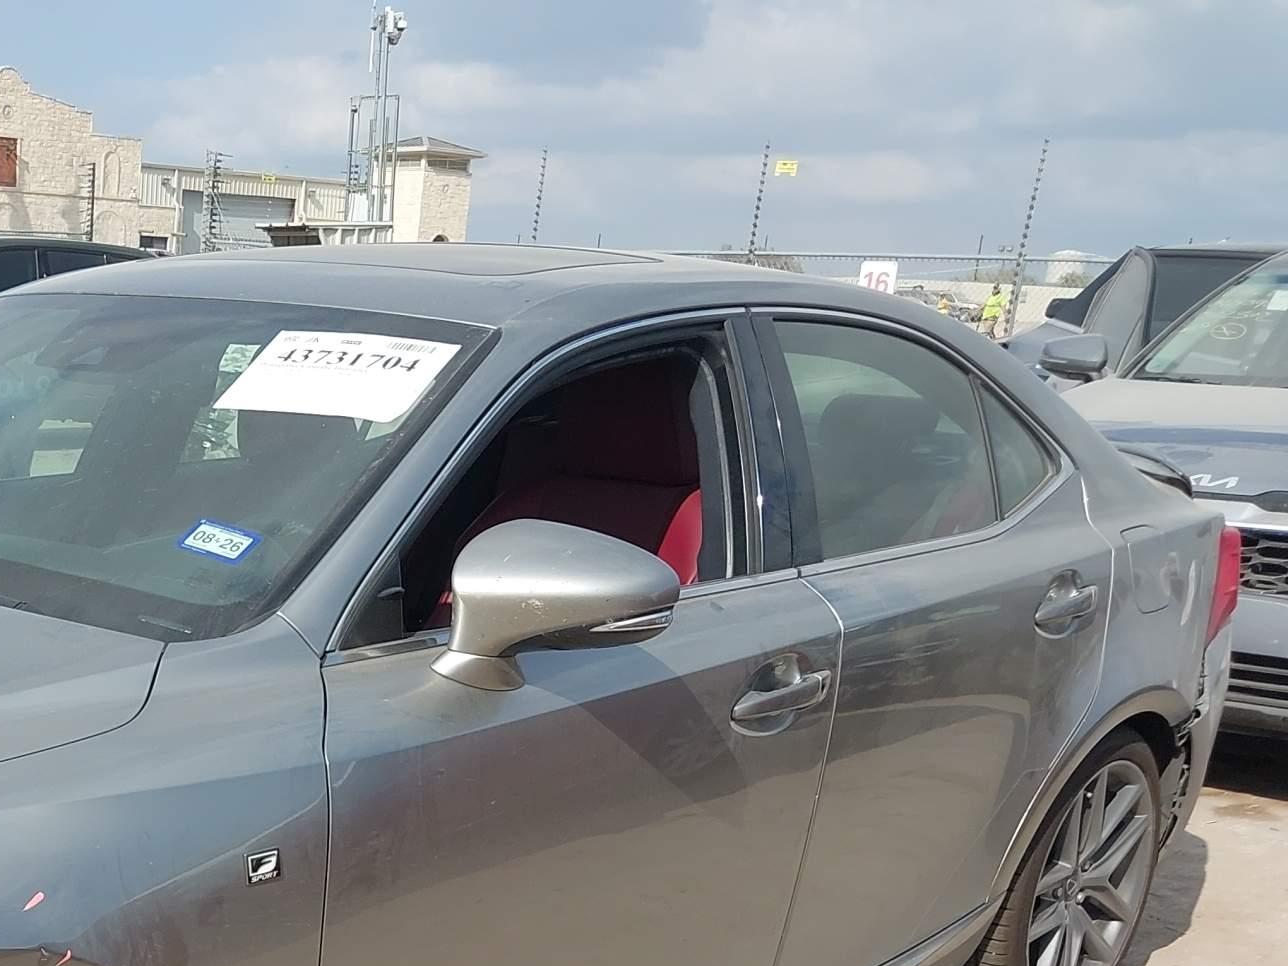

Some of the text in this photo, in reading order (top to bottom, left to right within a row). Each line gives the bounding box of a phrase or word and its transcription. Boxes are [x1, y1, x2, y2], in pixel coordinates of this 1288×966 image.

[863, 271, 890, 292] 16
[277, 348, 420, 372] 43731704
[250, 870, 279, 883] SPORT
